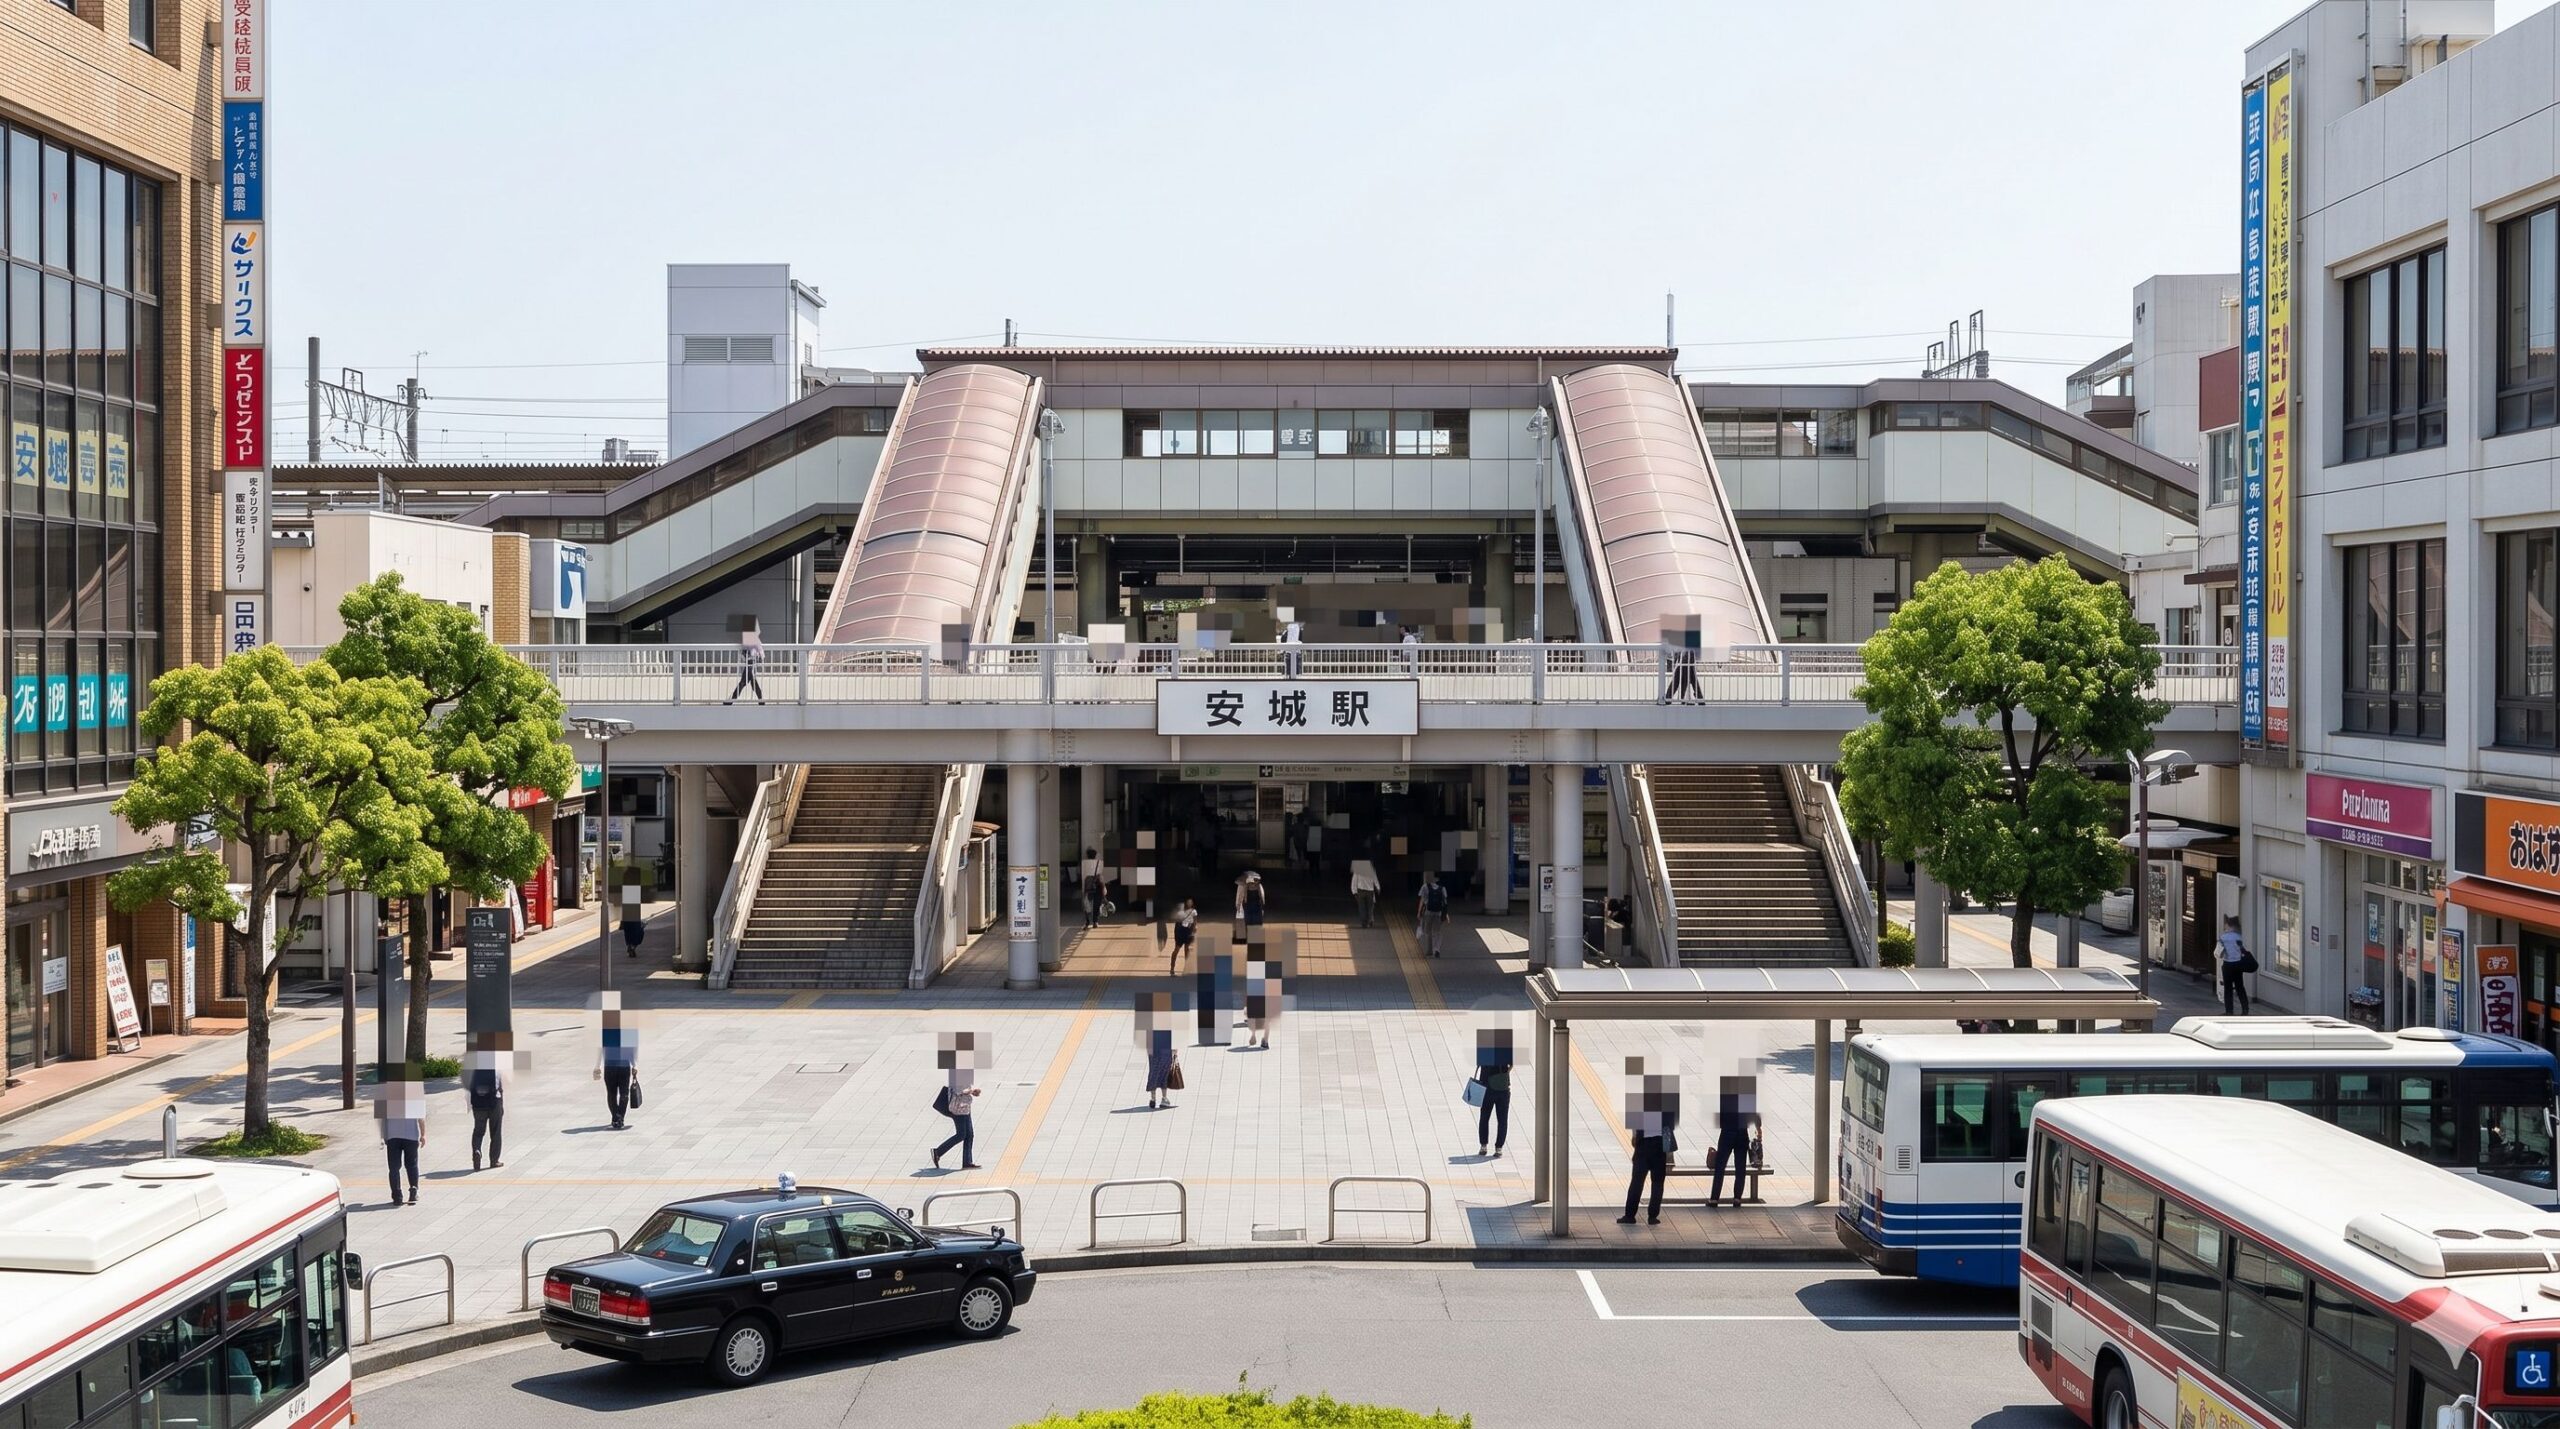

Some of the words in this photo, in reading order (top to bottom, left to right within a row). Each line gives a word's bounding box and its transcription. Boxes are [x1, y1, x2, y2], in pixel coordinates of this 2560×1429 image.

[233, 259, 254, 337] サリクス
[1206, 690, 1370, 728] 安城駅
